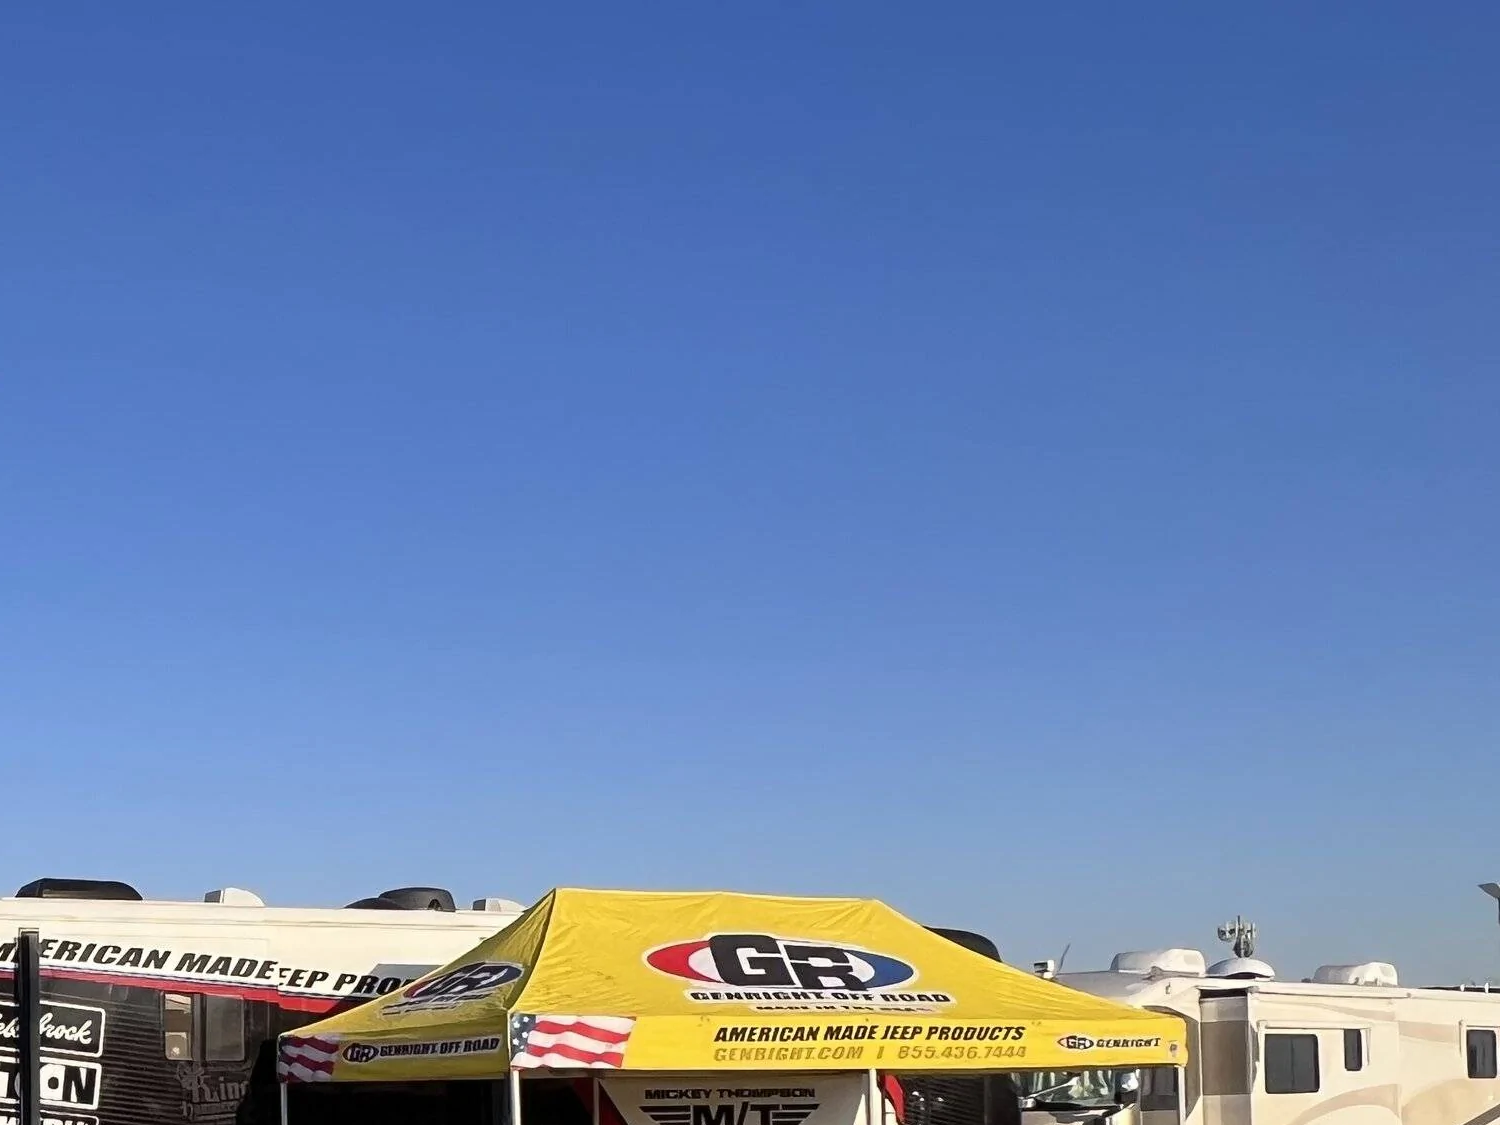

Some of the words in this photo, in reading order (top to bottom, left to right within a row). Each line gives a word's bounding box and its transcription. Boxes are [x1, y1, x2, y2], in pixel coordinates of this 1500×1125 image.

[706, 934, 869, 991] GR
[175, 952, 277, 979] MADE
[333, 974, 414, 996] PRO
[690, 991, 826, 1001] GENRIGHT
[831, 992, 875, 1002] OFF
[880, 993, 951, 1003] ROAD
[714, 1026, 819, 1042] AMERICAN
[823, 1025, 878, 1041] MADE
[880, 1025, 923, 1040] JEEP
[925, 1026, 1026, 1041] PRODUCTS
[379, 1043, 439, 1057] GENRIGHT
[440, 1041, 464, 1055] OFF
[464, 1038, 501, 1053] ROAD
[1096, 1037, 1161, 1048] GENRIGHT
[714, 1046, 863, 1061] GENRIGHT.COM
[898, 1045, 1027, 1060] 855.436.7444
[645, 1089, 712, 1099] MICKEY
[716, 1088, 816, 1098] THOMPSON
